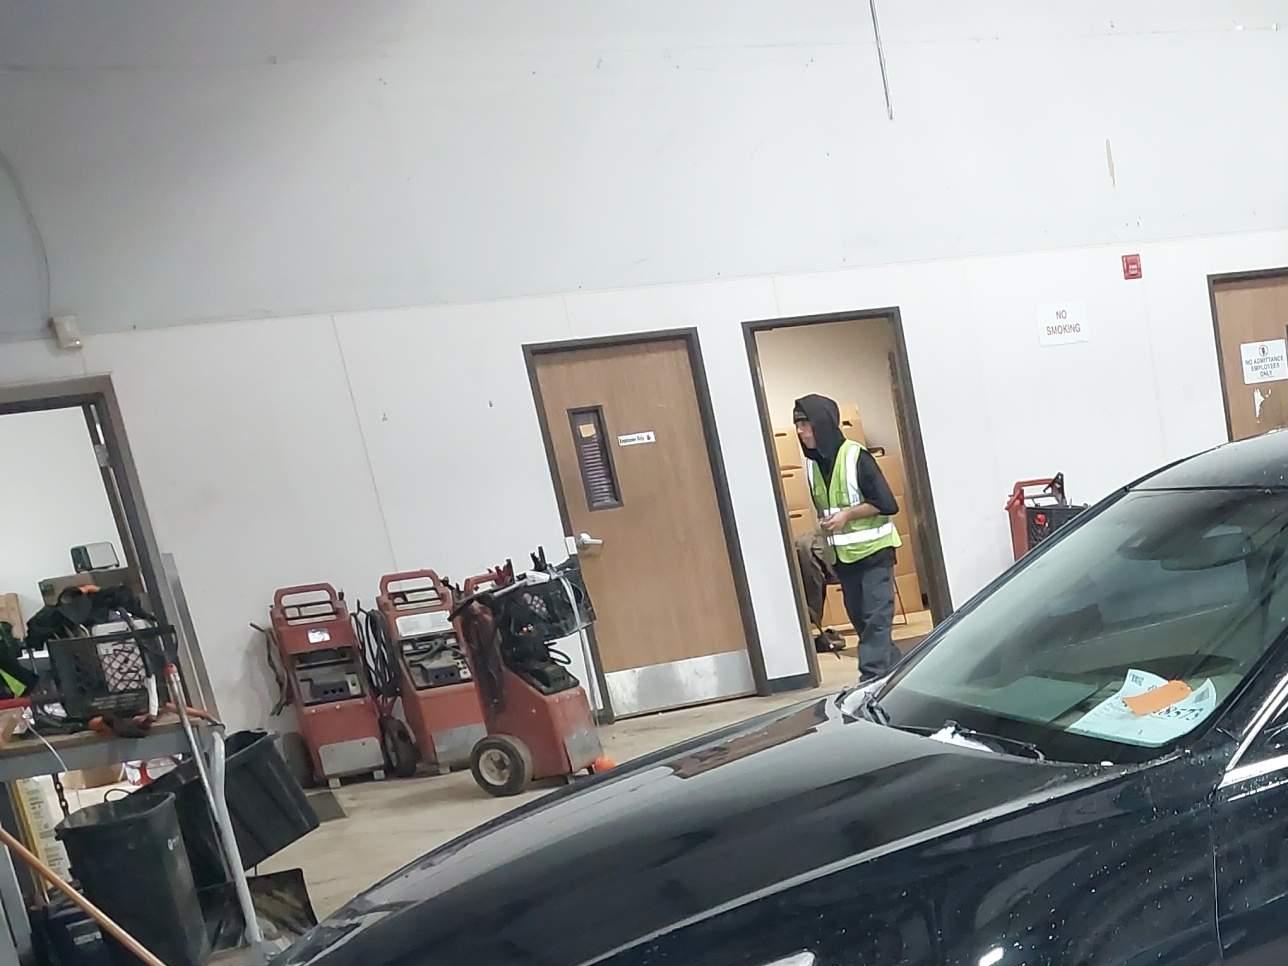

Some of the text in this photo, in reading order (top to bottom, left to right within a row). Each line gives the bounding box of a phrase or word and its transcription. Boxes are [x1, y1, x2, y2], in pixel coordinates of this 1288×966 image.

[1056, 309, 1067, 320] NO
[1046, 323, 1081, 336] SMOKING
[1254, 355, 1284, 365] ADMITTANCE
[1251, 362, 1281, 372] EMPLOYEES
